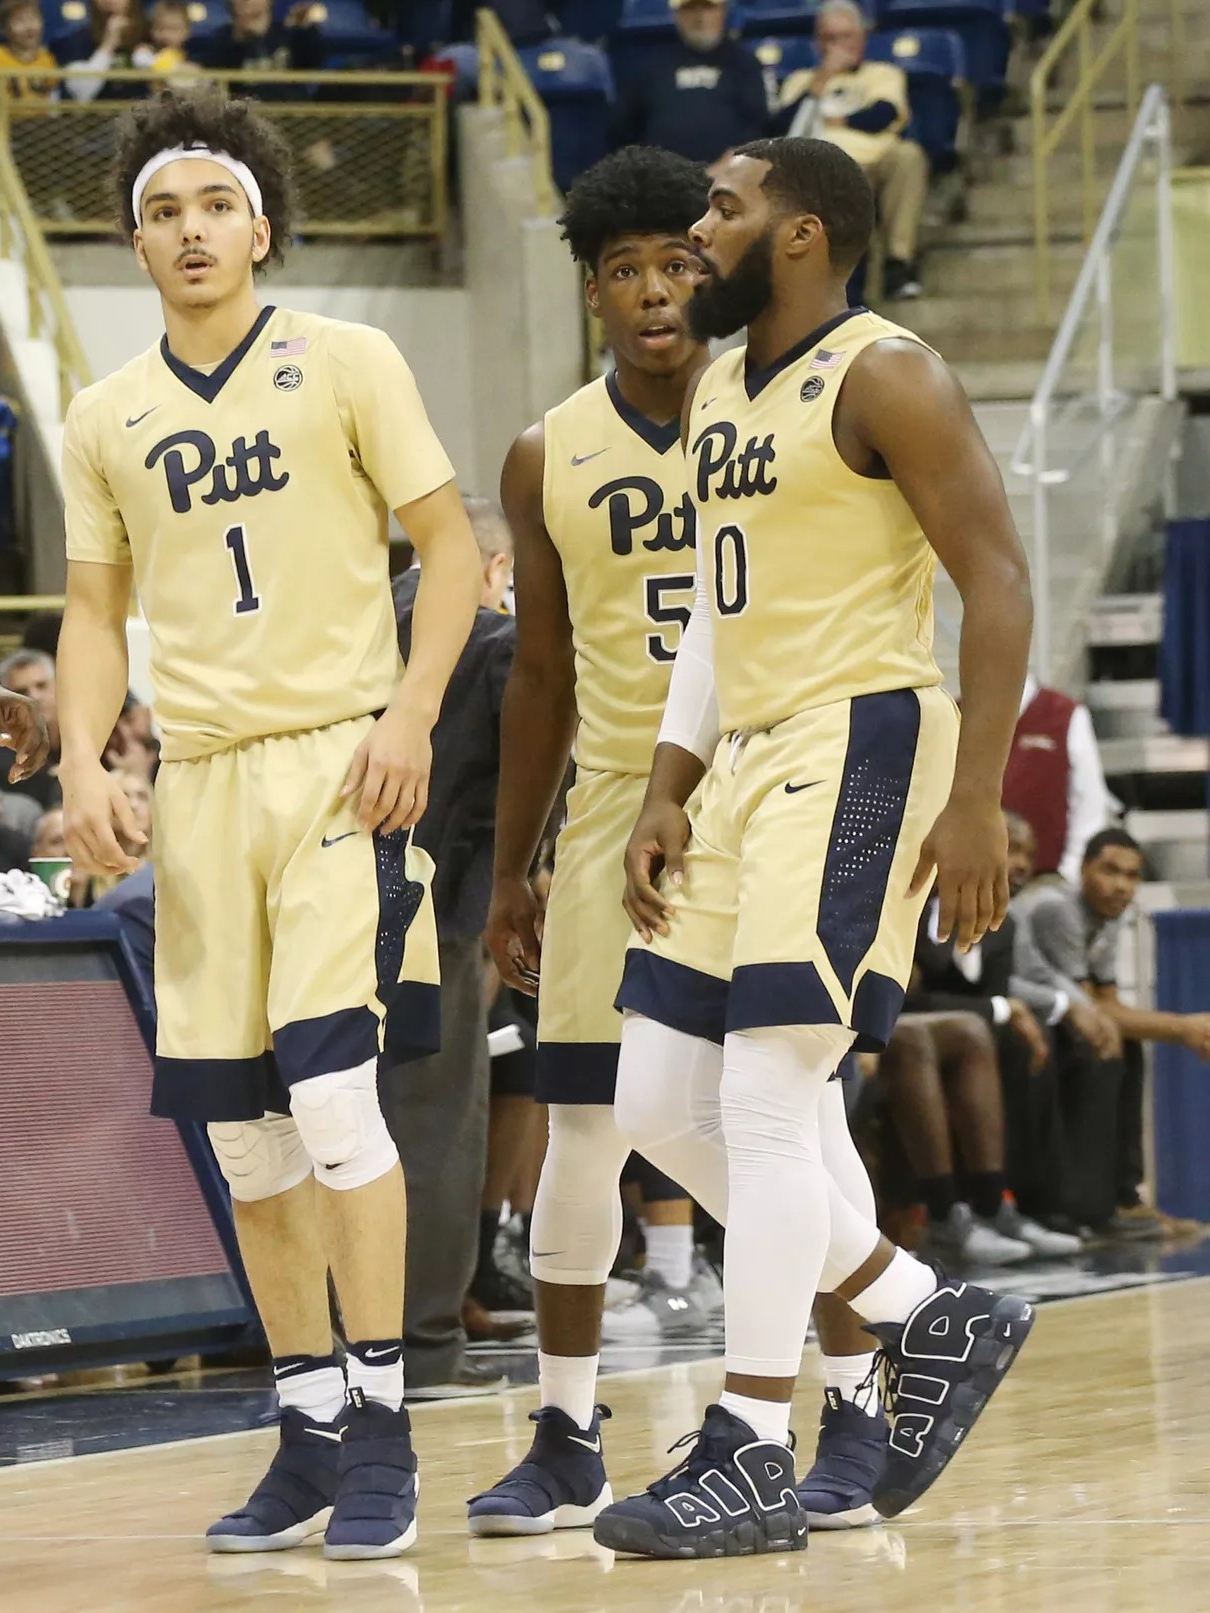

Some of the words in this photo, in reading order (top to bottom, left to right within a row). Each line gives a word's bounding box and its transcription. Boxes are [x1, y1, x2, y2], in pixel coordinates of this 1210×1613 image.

[145, 430, 289, 513] Pitt
[692, 421, 777, 502] Pitt
[588, 476, 696, 555] Pit
[224, 523, 261, 616] 1
[714, 522, 749, 618] 0
[643, 572, 697, 664] 5
[664, 1439, 800, 1527] AIR
